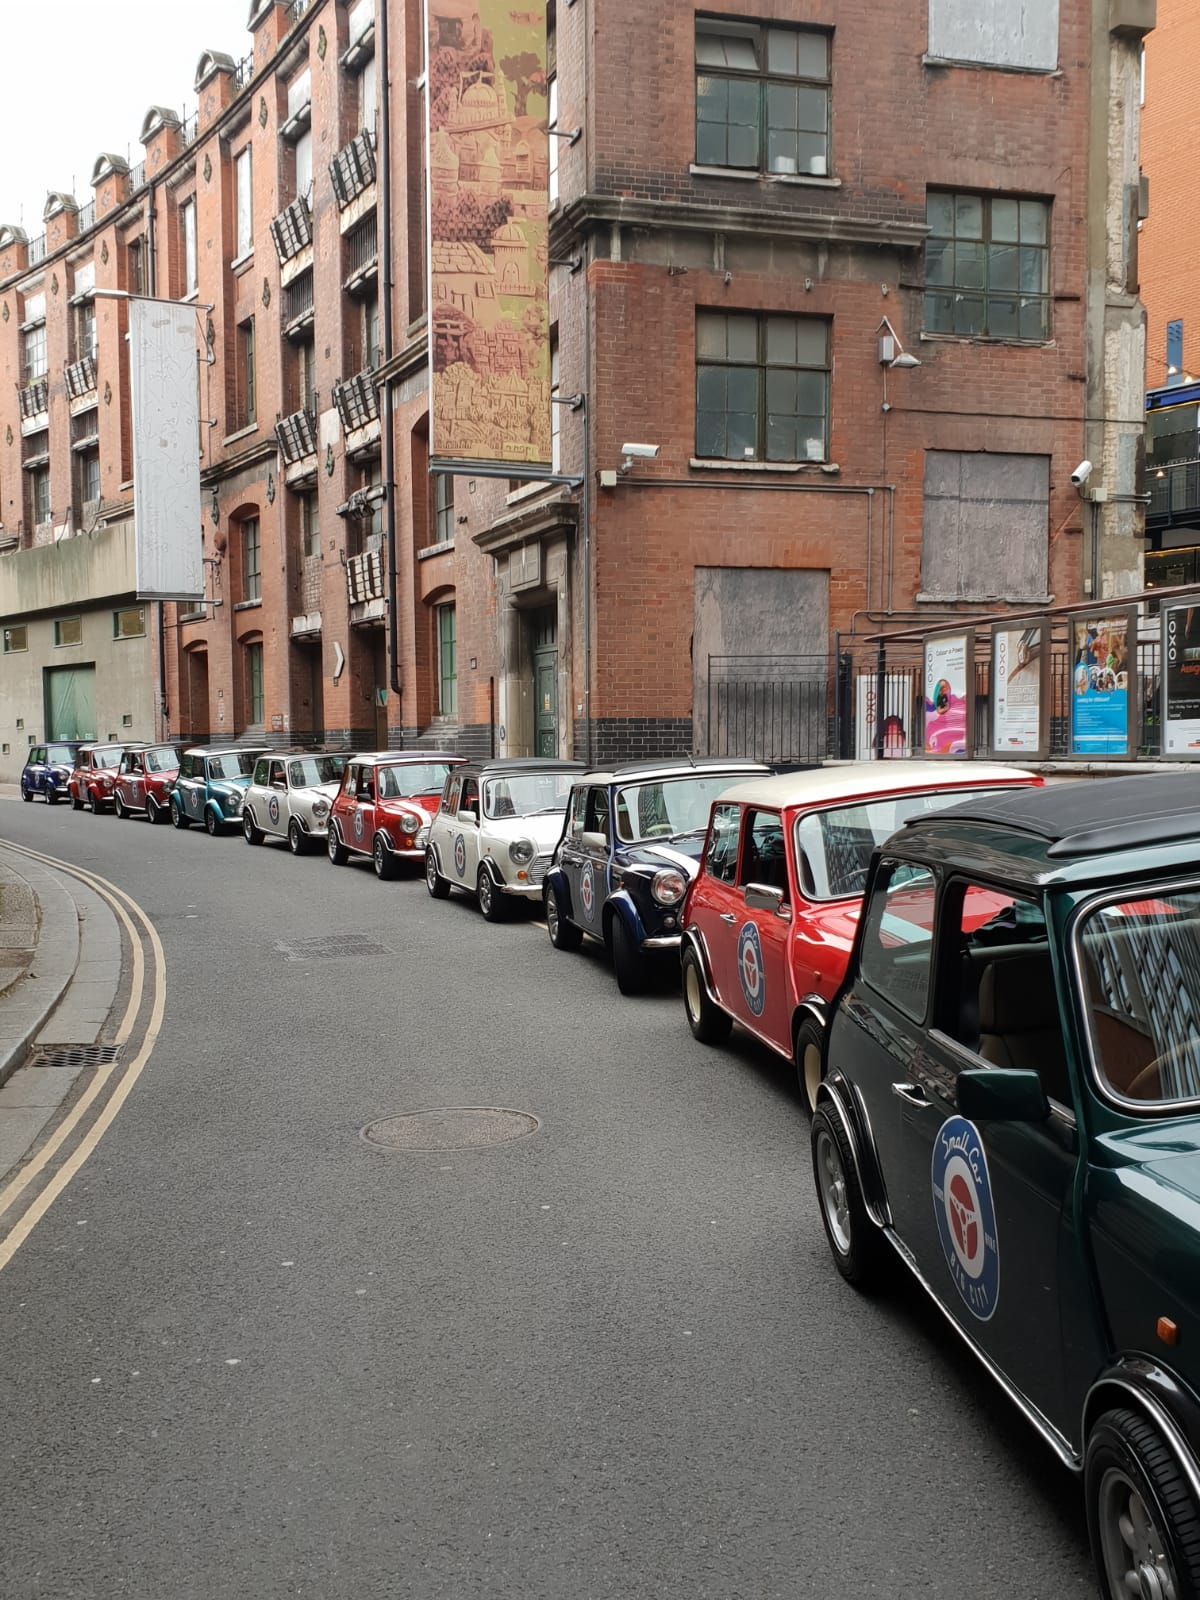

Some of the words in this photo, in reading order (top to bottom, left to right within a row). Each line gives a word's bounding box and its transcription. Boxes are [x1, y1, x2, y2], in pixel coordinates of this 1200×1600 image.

[1168, 620, 1177, 661] OXO
[866, 691, 876, 724] OXO
[941, 1130, 969, 1160] Small
[968, 1147, 983, 1186] Car
[950, 1252, 965, 1291] BIG
[969, 1284, 990, 1309] CITY
